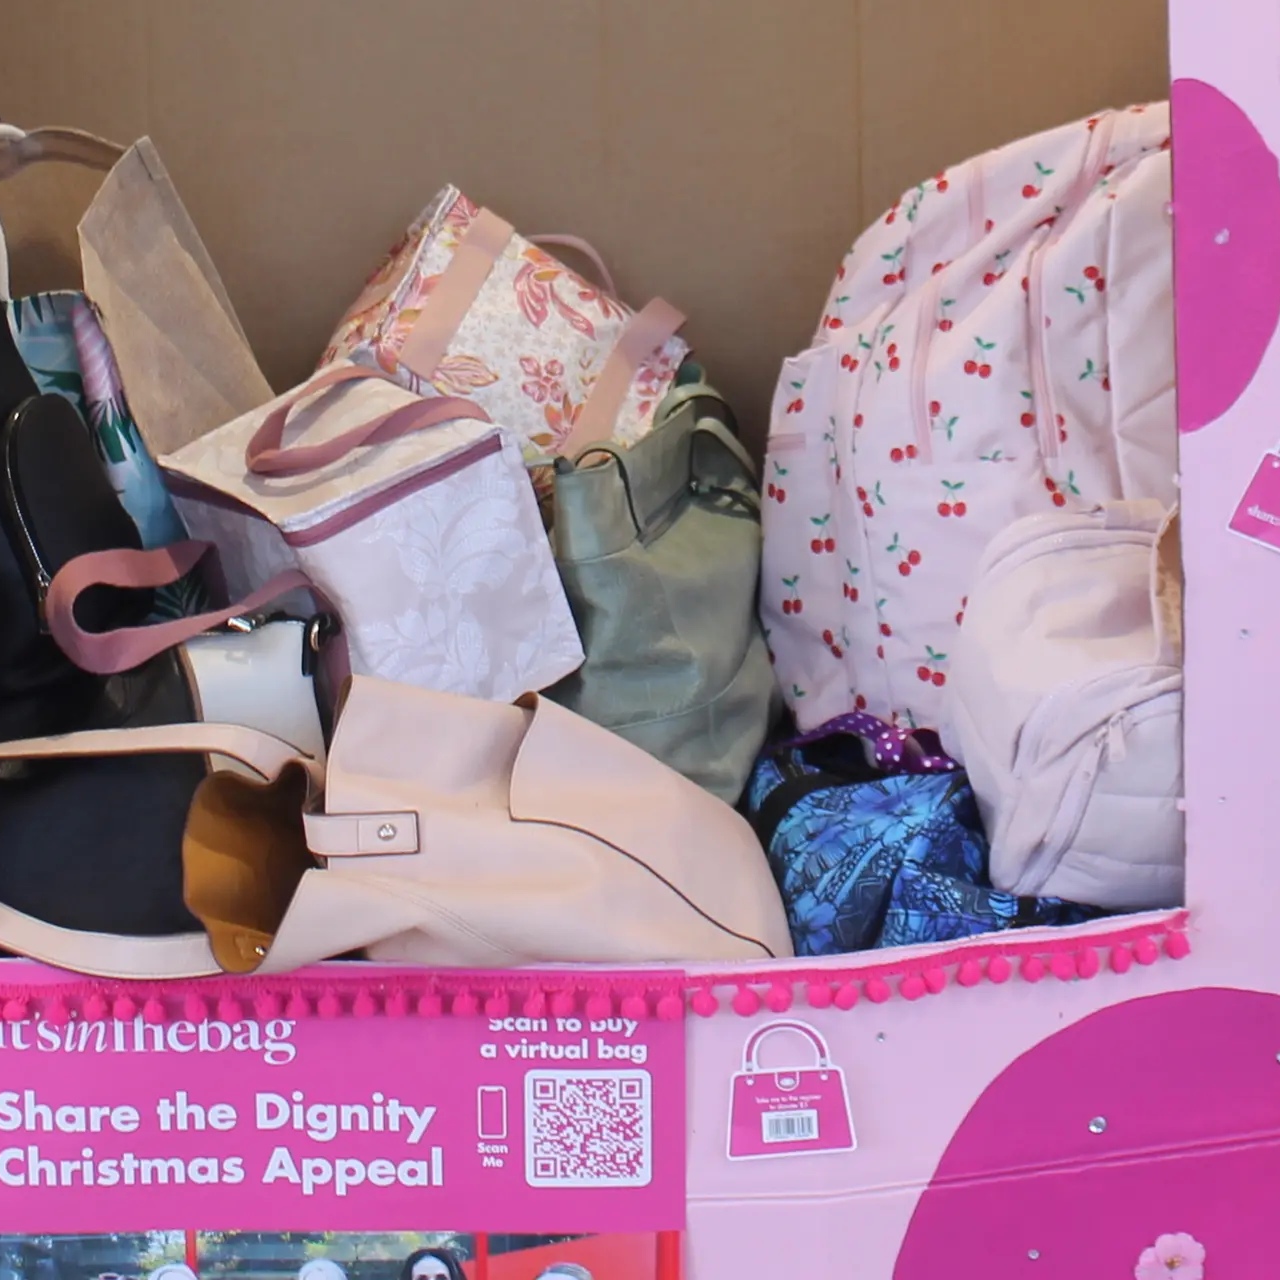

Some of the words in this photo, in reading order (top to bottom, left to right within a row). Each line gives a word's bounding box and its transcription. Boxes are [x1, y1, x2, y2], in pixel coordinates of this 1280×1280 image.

[556, 1017, 582, 1033] to
[480, 1043, 497, 1060] a
[504, 1038, 589, 1060] virtual
[597, 1039, 648, 1064] bag
[156, 1091, 238, 1131] the
[255, 1091, 437, 1144] Dignity
[477, 1142, 508, 1154] Scan
[261, 1146, 443, 1196] Appeal
[482, 1156, 504, 1168] Me
